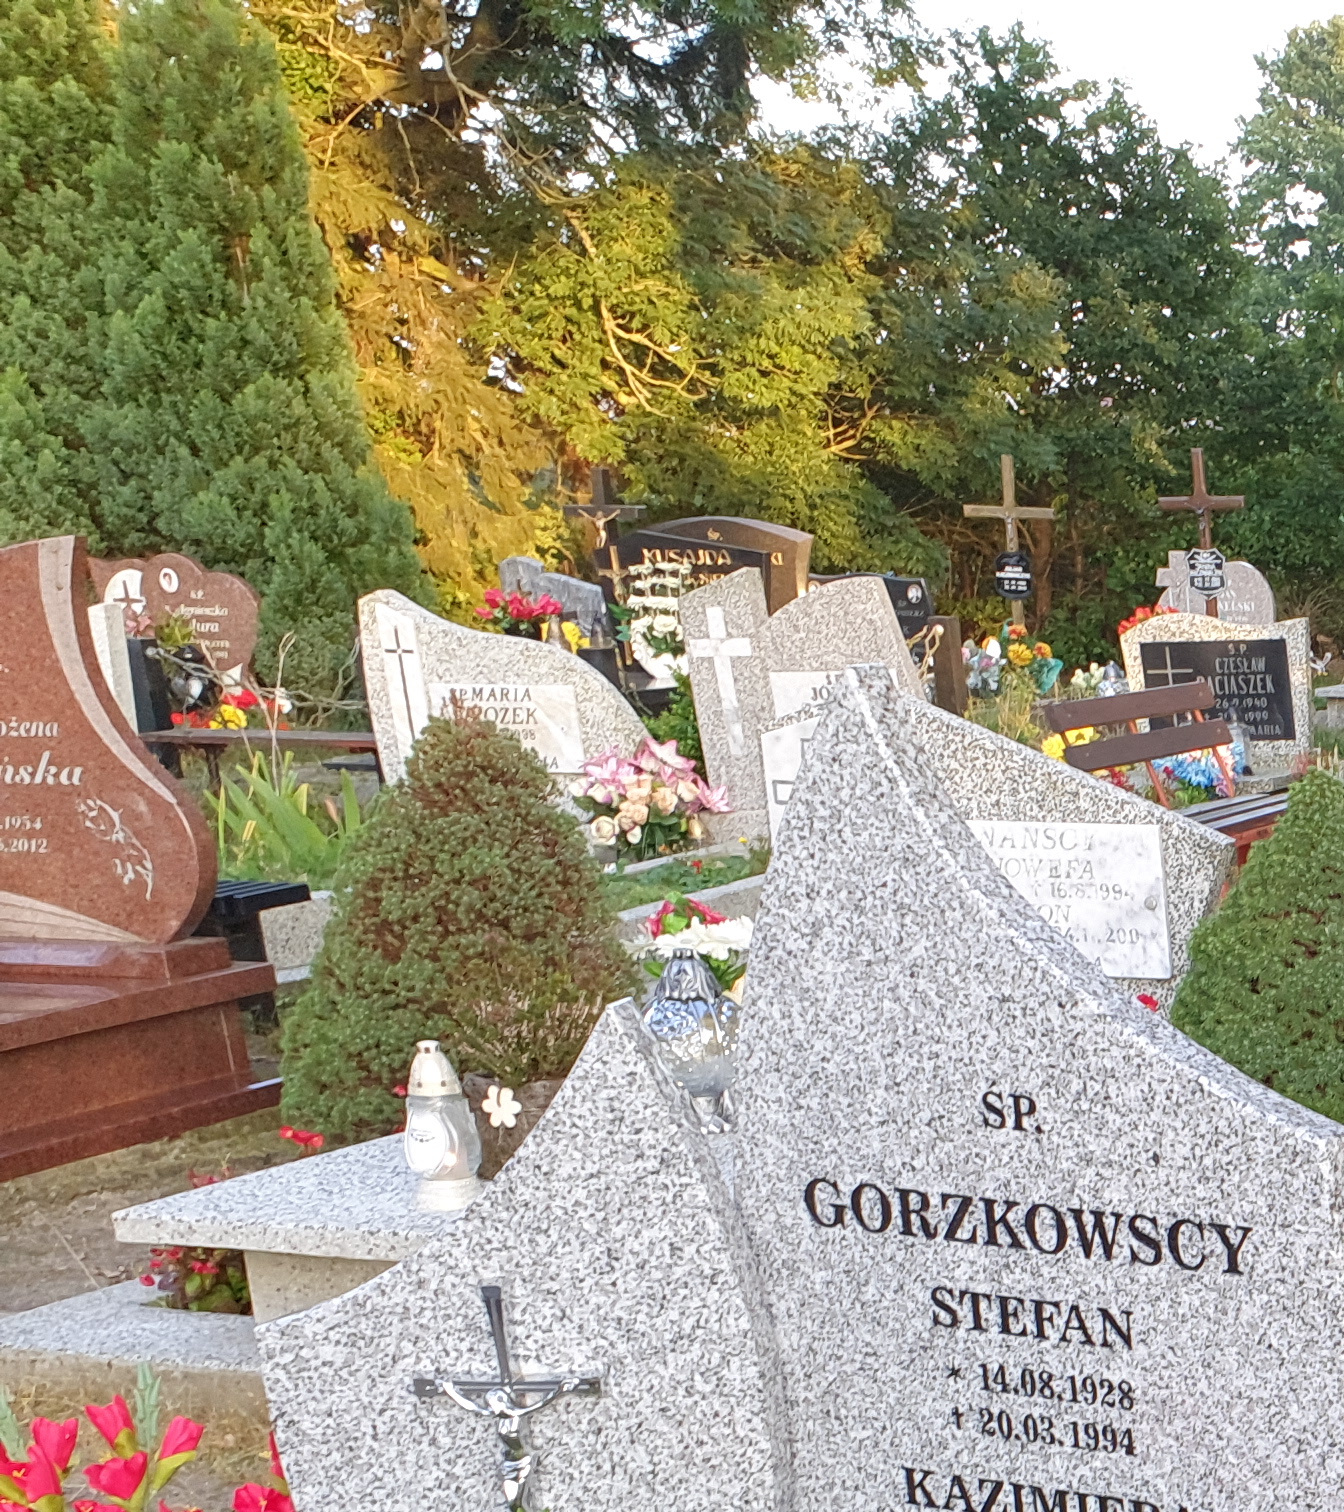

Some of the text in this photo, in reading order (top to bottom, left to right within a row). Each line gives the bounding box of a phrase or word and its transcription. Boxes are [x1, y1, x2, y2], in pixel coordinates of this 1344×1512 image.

[642, 549, 731, 566] KUSAJDA
[1214, 656, 1267, 674] CZESŁAW
[471, 687, 533, 702] MARIA
[999, 857, 1095, 880] OWEFA
[804, 1176, 1254, 1276] GORZKOWSCY
[930, 1286, 1134, 1350] STEFAN
[978, 1363, 1136, 1412] 14.08.1928
[980, 1406, 1137, 1457] 20.03.1994
